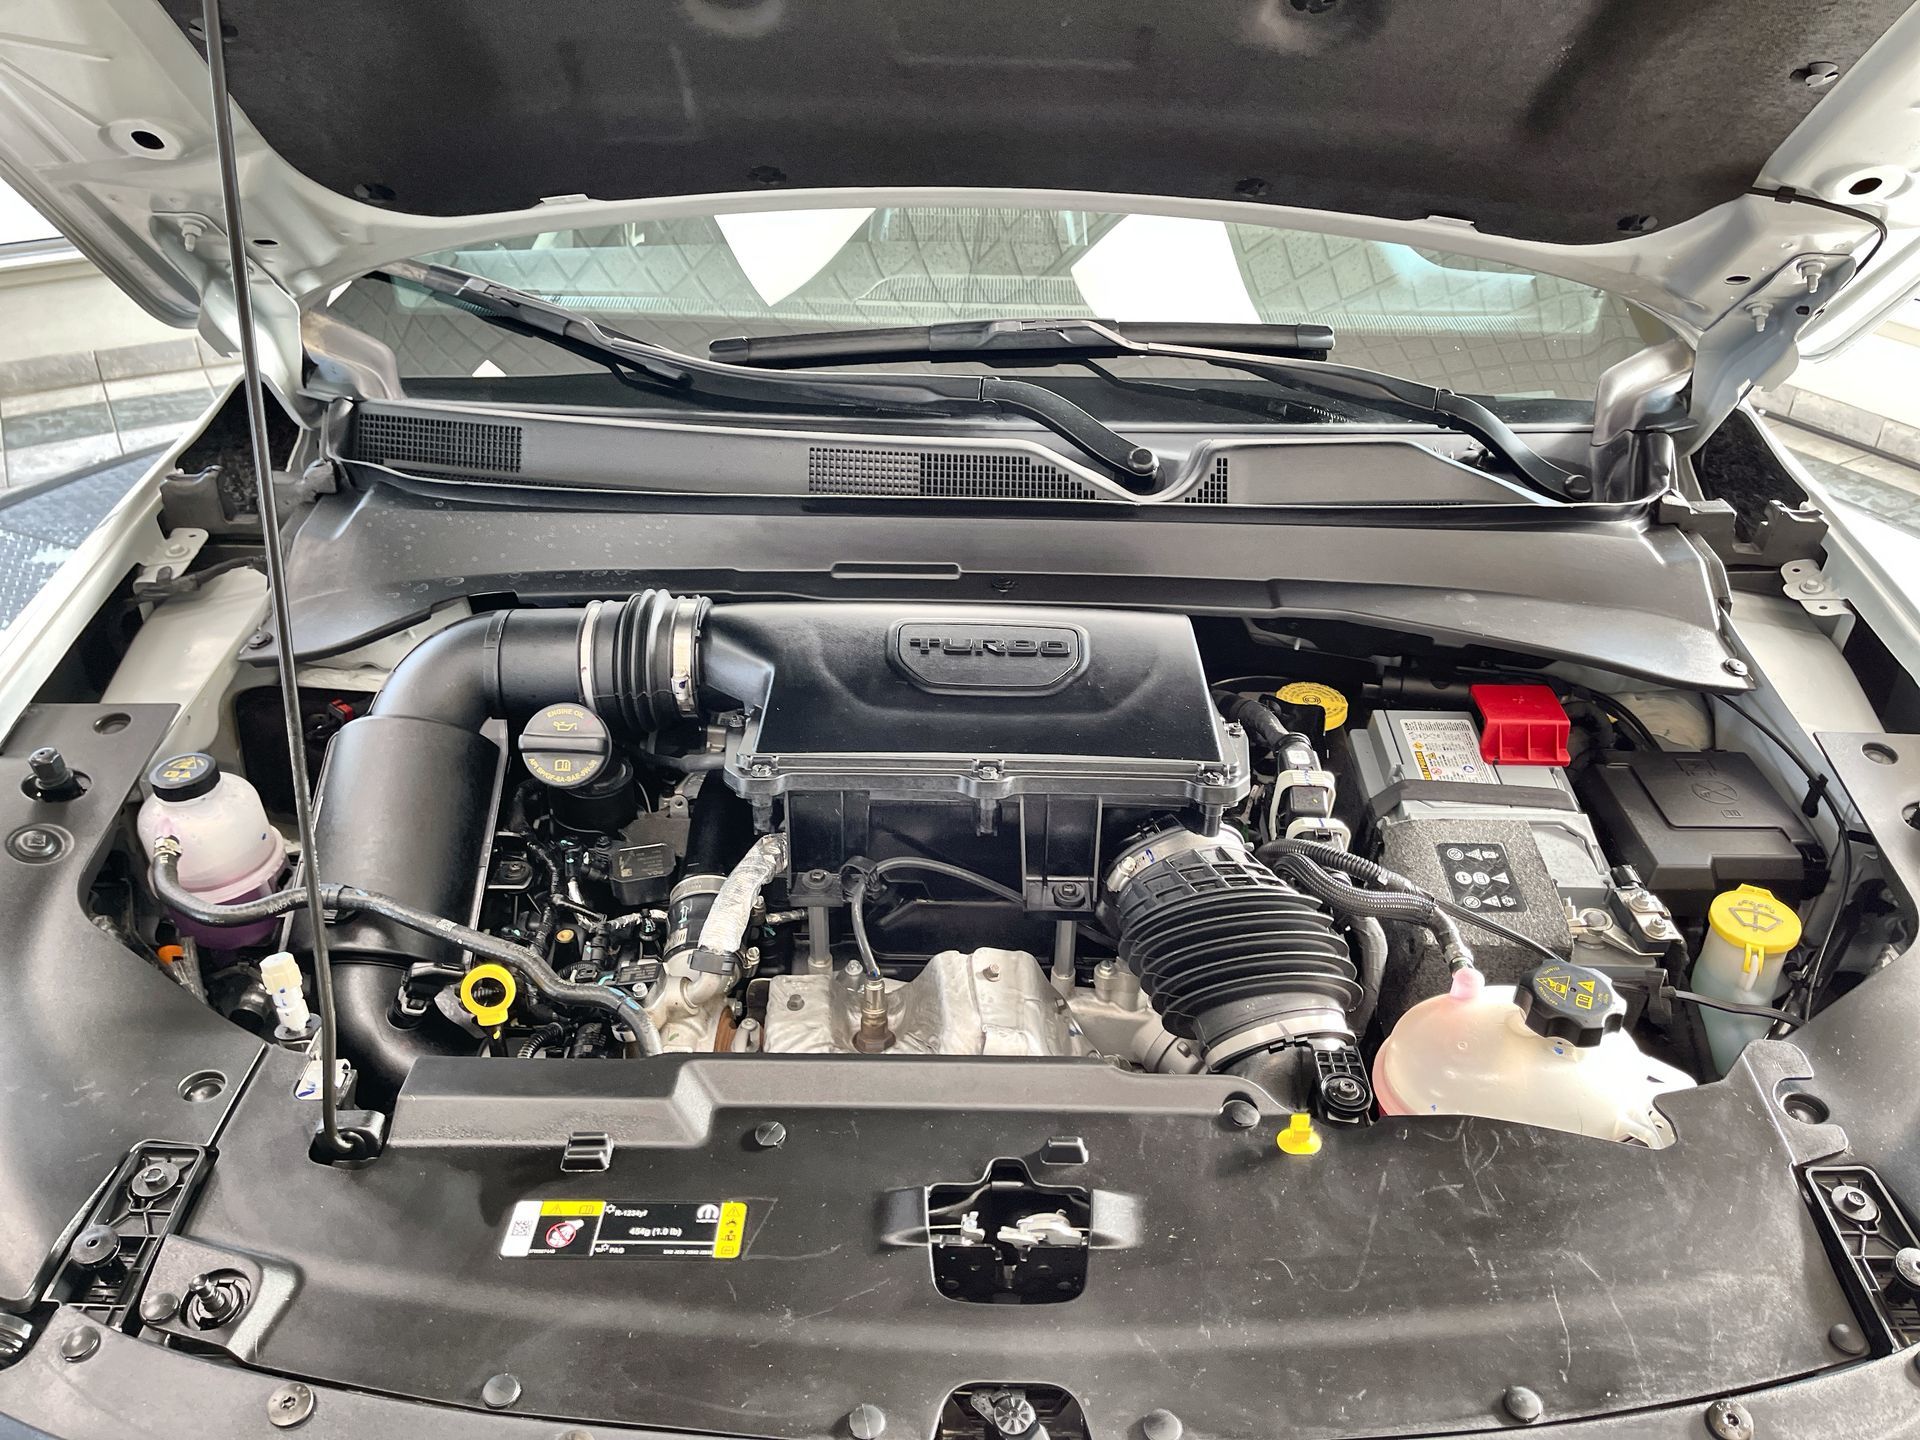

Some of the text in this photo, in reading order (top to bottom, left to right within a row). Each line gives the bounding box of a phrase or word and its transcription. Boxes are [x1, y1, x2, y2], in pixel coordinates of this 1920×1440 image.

[909, 637, 1072, 658] TURBO
[547, 708, 573, 718] ENGINE
[628, 1226, 683, 1238] 454g (1.0 lb)
[608, 1246, 626, 1255] PAG
